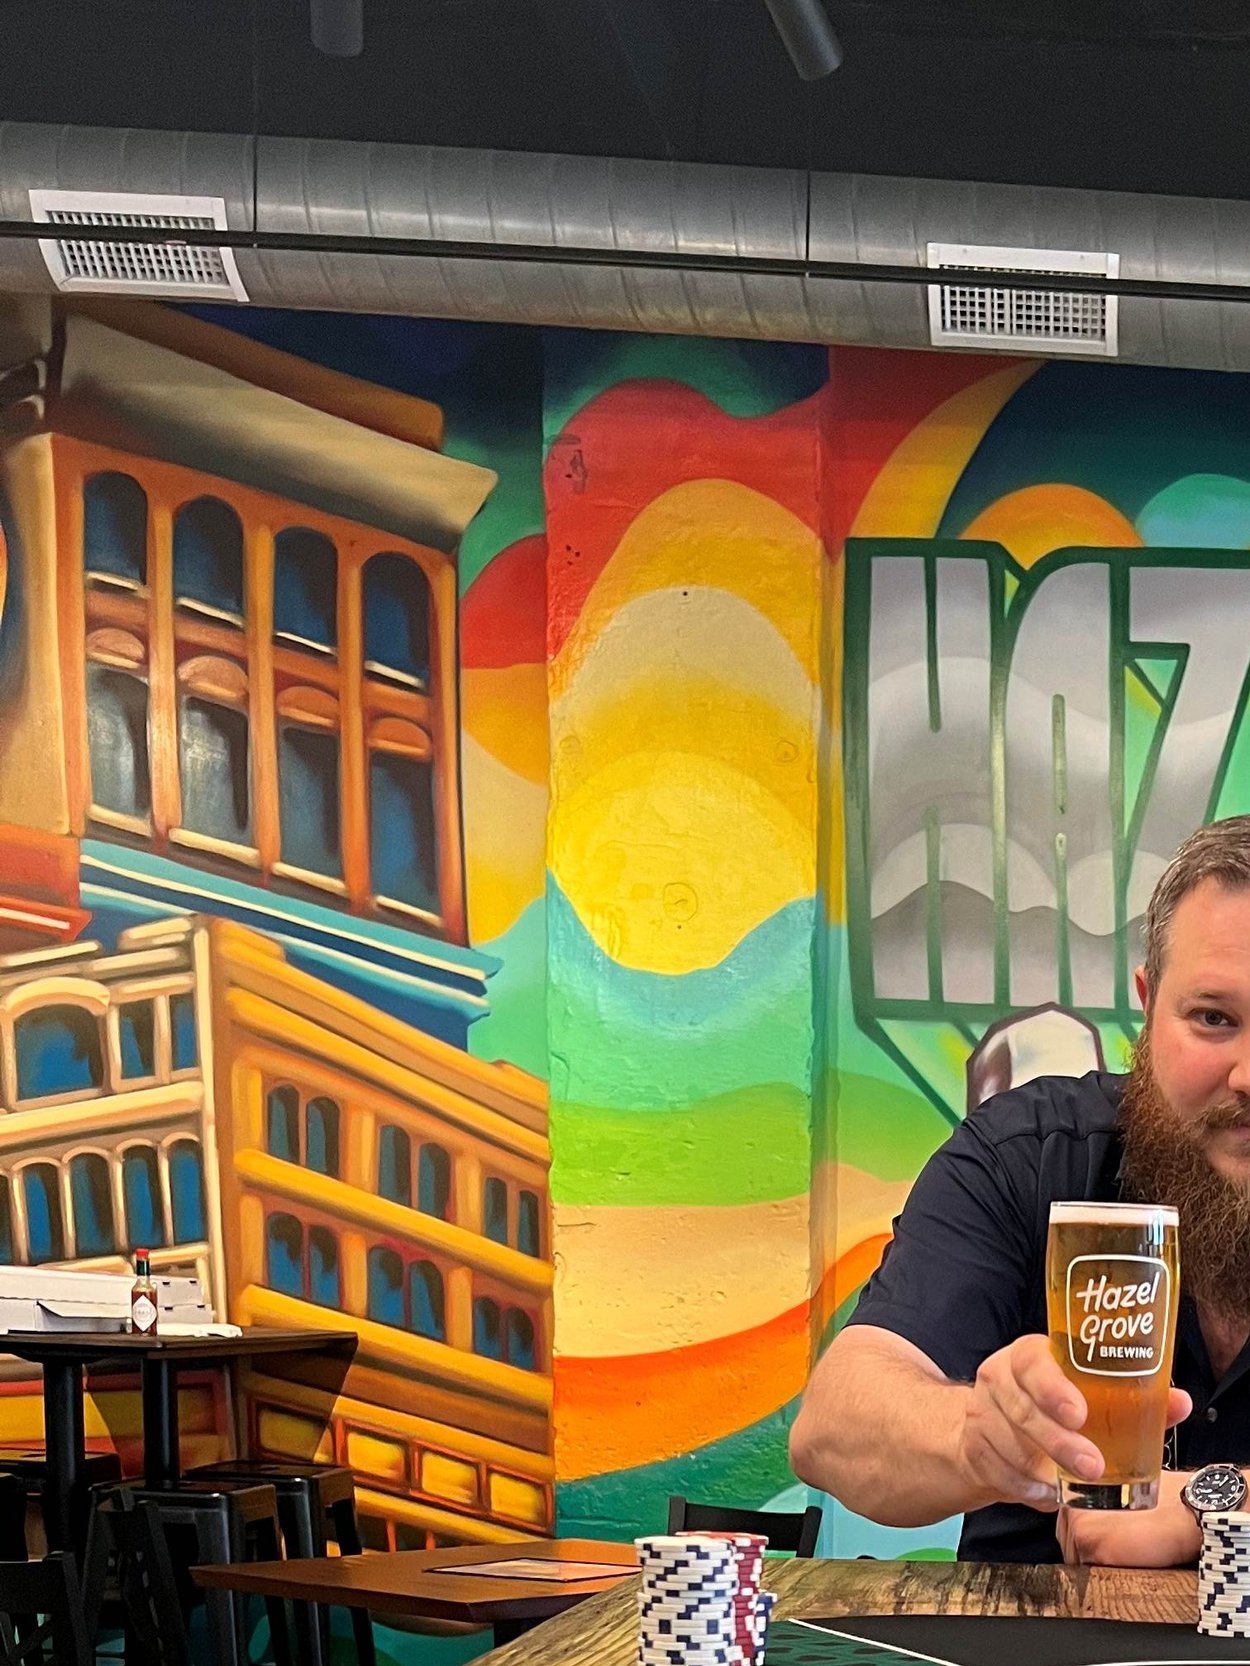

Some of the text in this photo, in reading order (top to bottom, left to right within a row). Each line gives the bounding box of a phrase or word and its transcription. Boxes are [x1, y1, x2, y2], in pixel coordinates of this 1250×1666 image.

[1076, 1271, 1160, 1312] Hazel
[1080, 1312, 1154, 1362] Grove
[1100, 1345, 1154, 1359] BREWING
